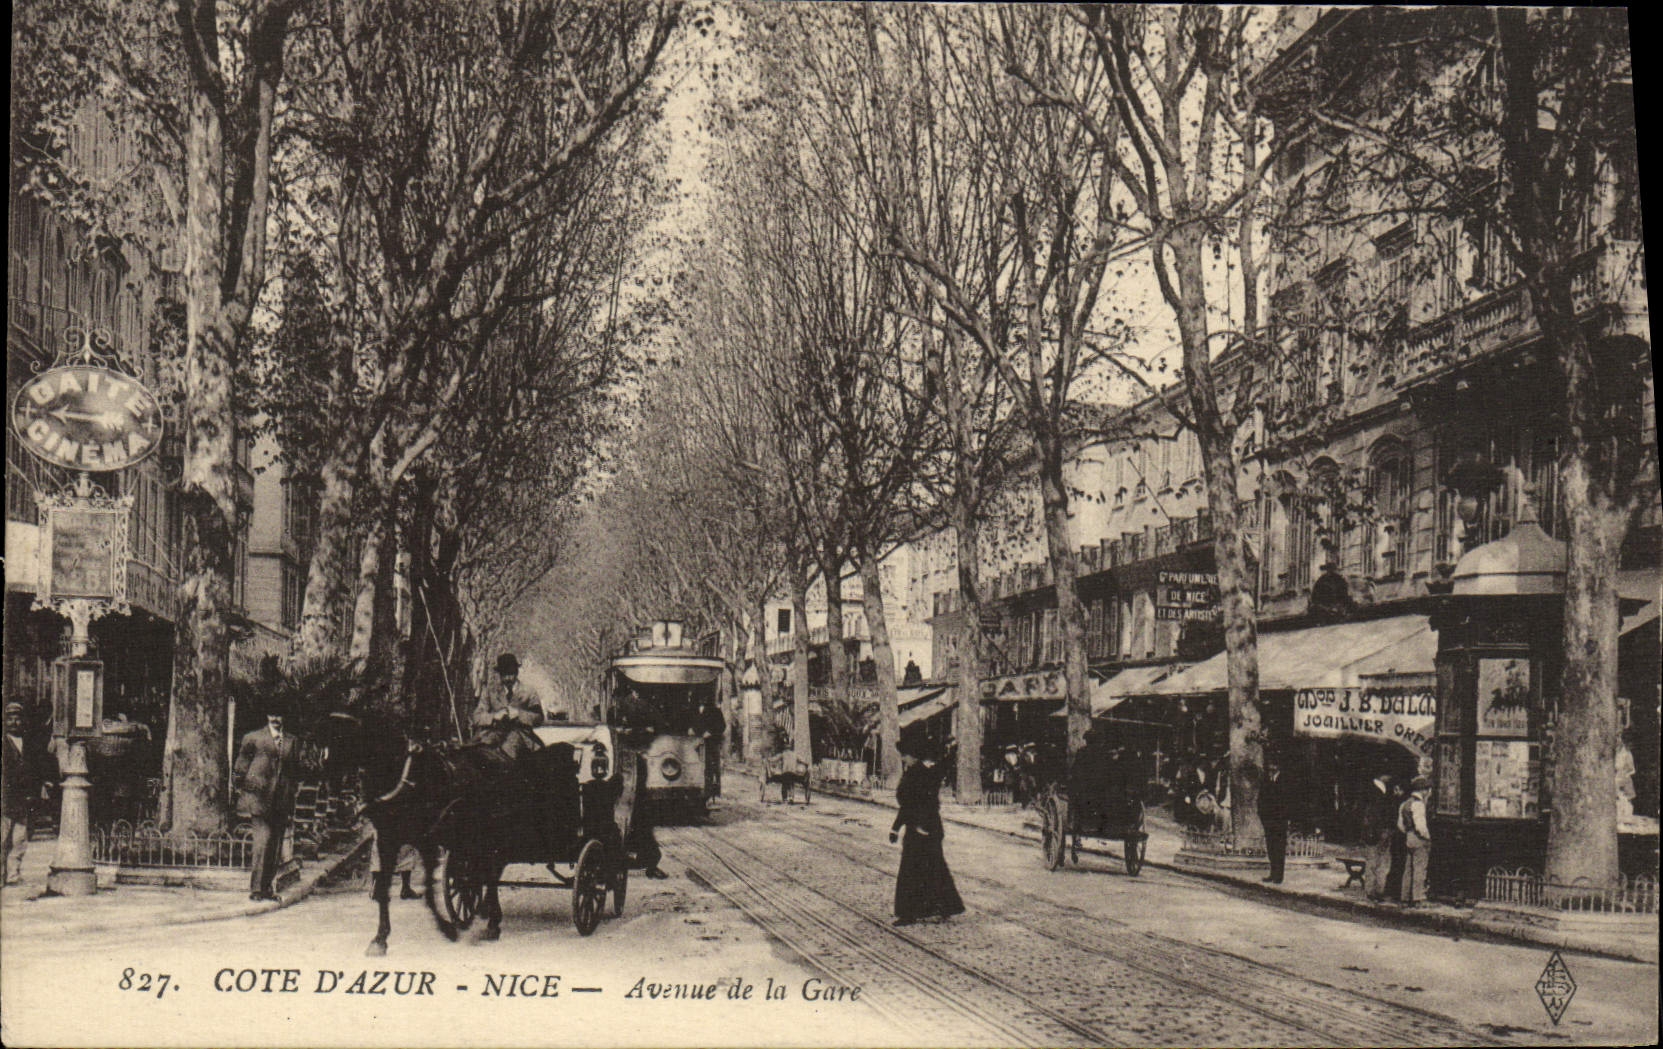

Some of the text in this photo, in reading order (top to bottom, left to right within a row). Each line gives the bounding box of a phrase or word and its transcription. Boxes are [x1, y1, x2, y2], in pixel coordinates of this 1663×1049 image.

[1170, 590, 1207, 603] DE NICE
[1338, 690, 1355, 713] J.
[1358, 693, 1377, 714] B.
[1303, 714, 1384, 734] JOAILLIER
